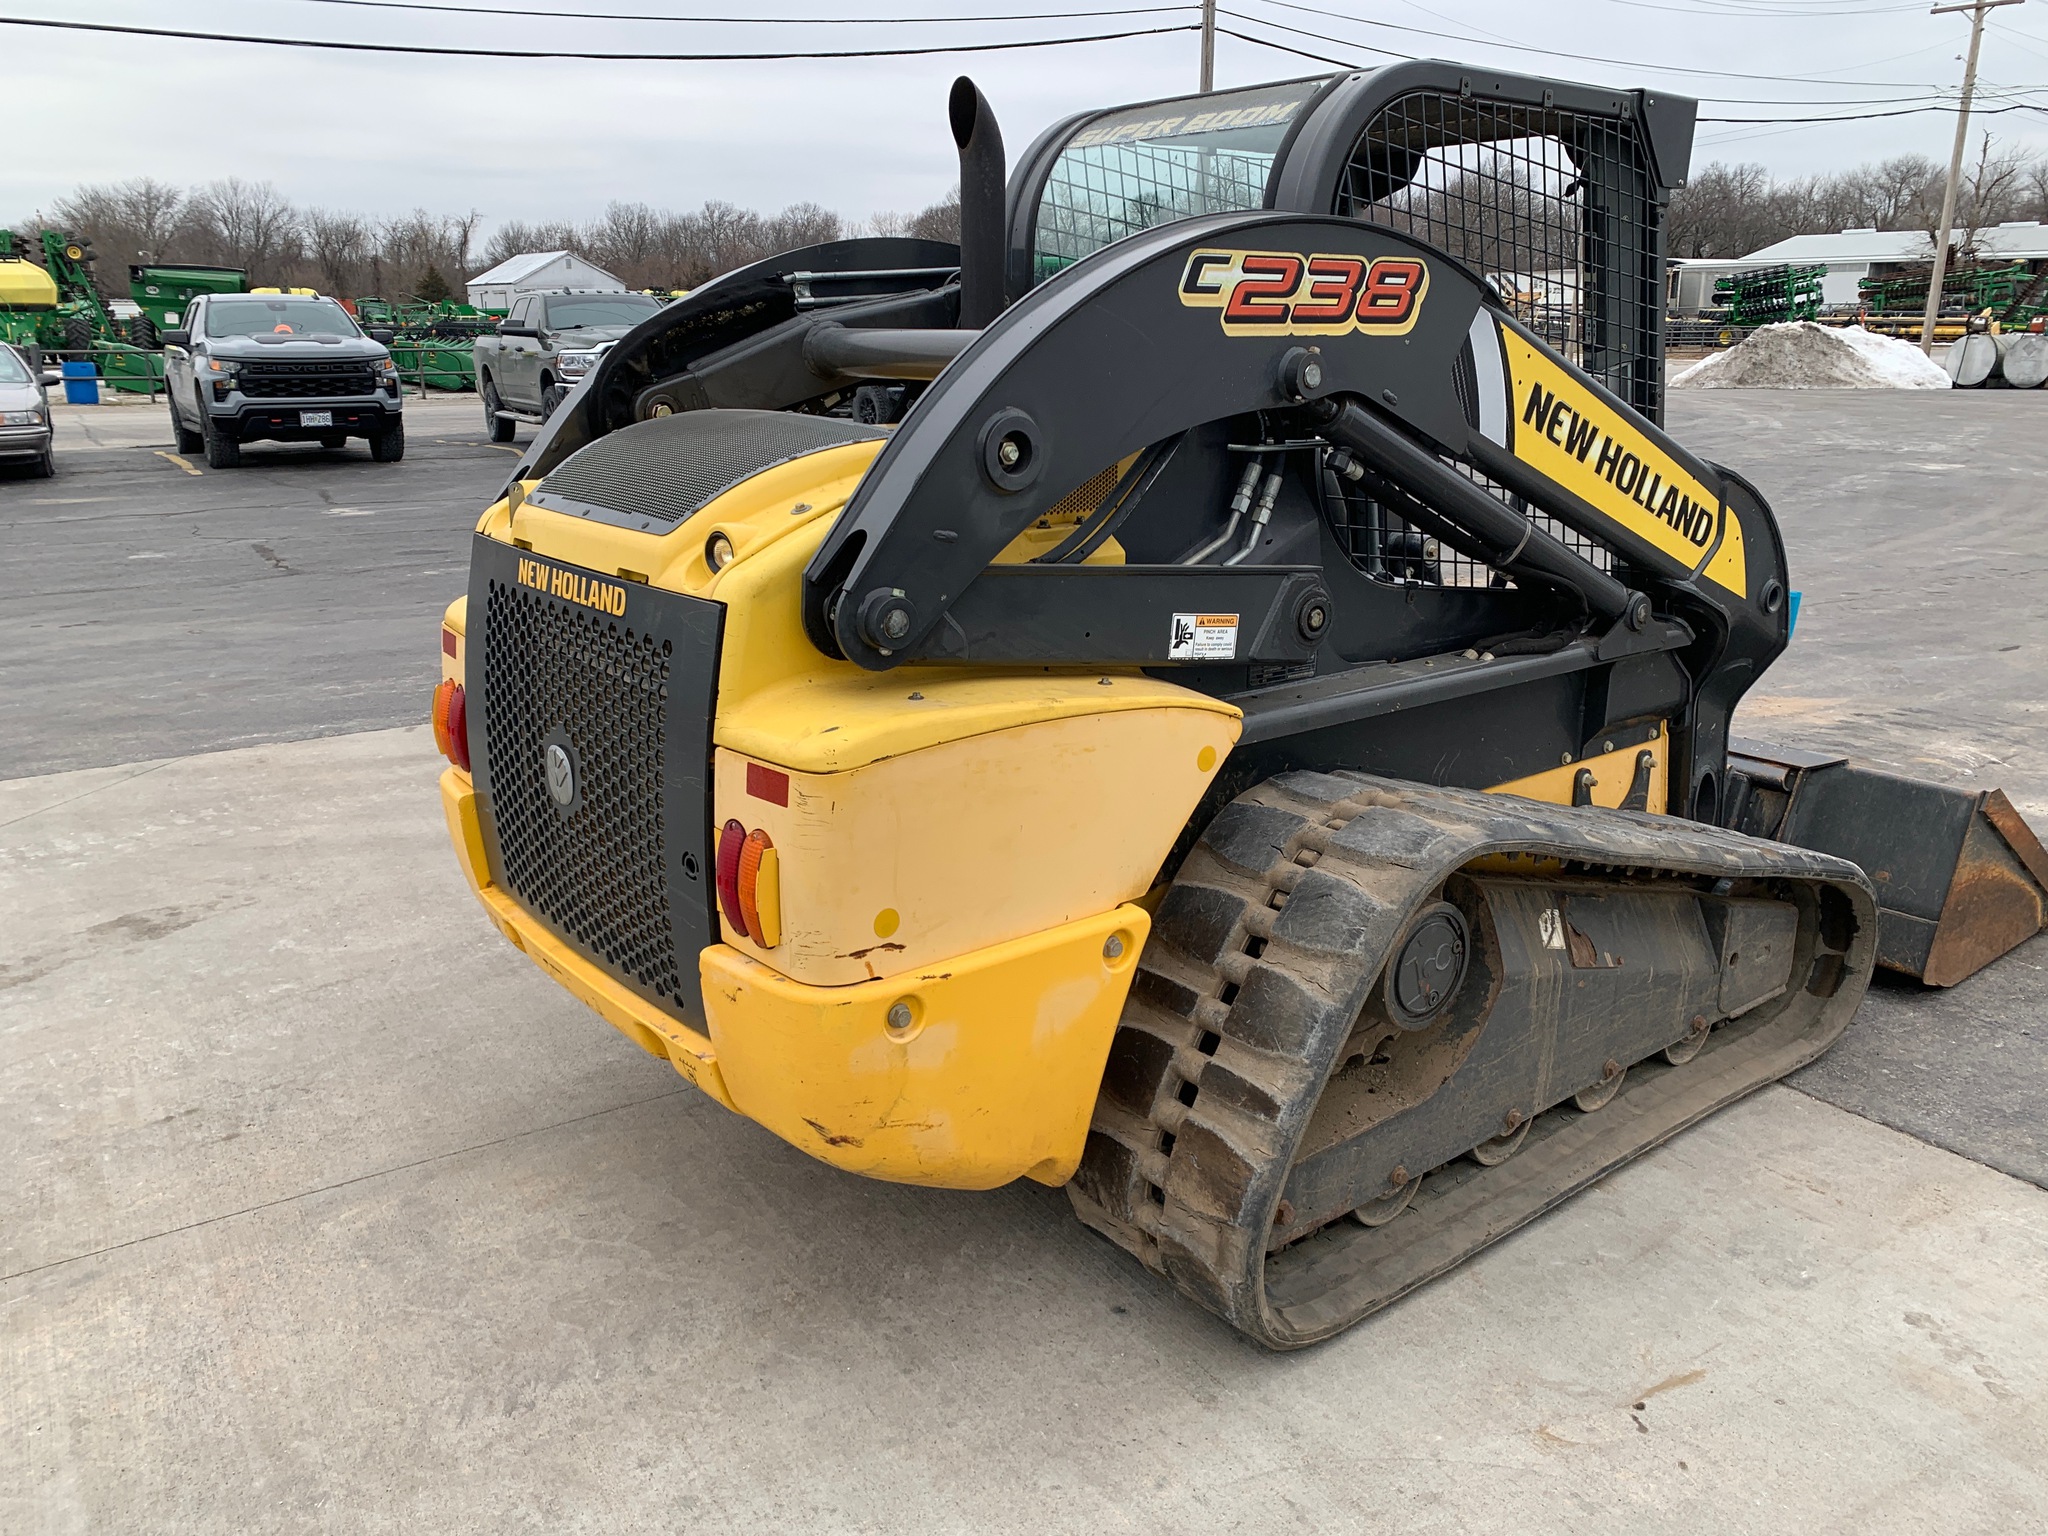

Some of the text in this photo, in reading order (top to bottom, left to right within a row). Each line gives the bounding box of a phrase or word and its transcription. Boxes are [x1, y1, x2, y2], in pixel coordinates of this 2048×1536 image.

[1070, 101, 1302, 148] SUPER BOOM
[1179, 249, 1430, 335] C238
[250, 364, 365, 373] CHEVROLET
[1522, 381, 1715, 548] NEW HOLLAND
[517, 557, 627, 617] NEW HOLLAND
